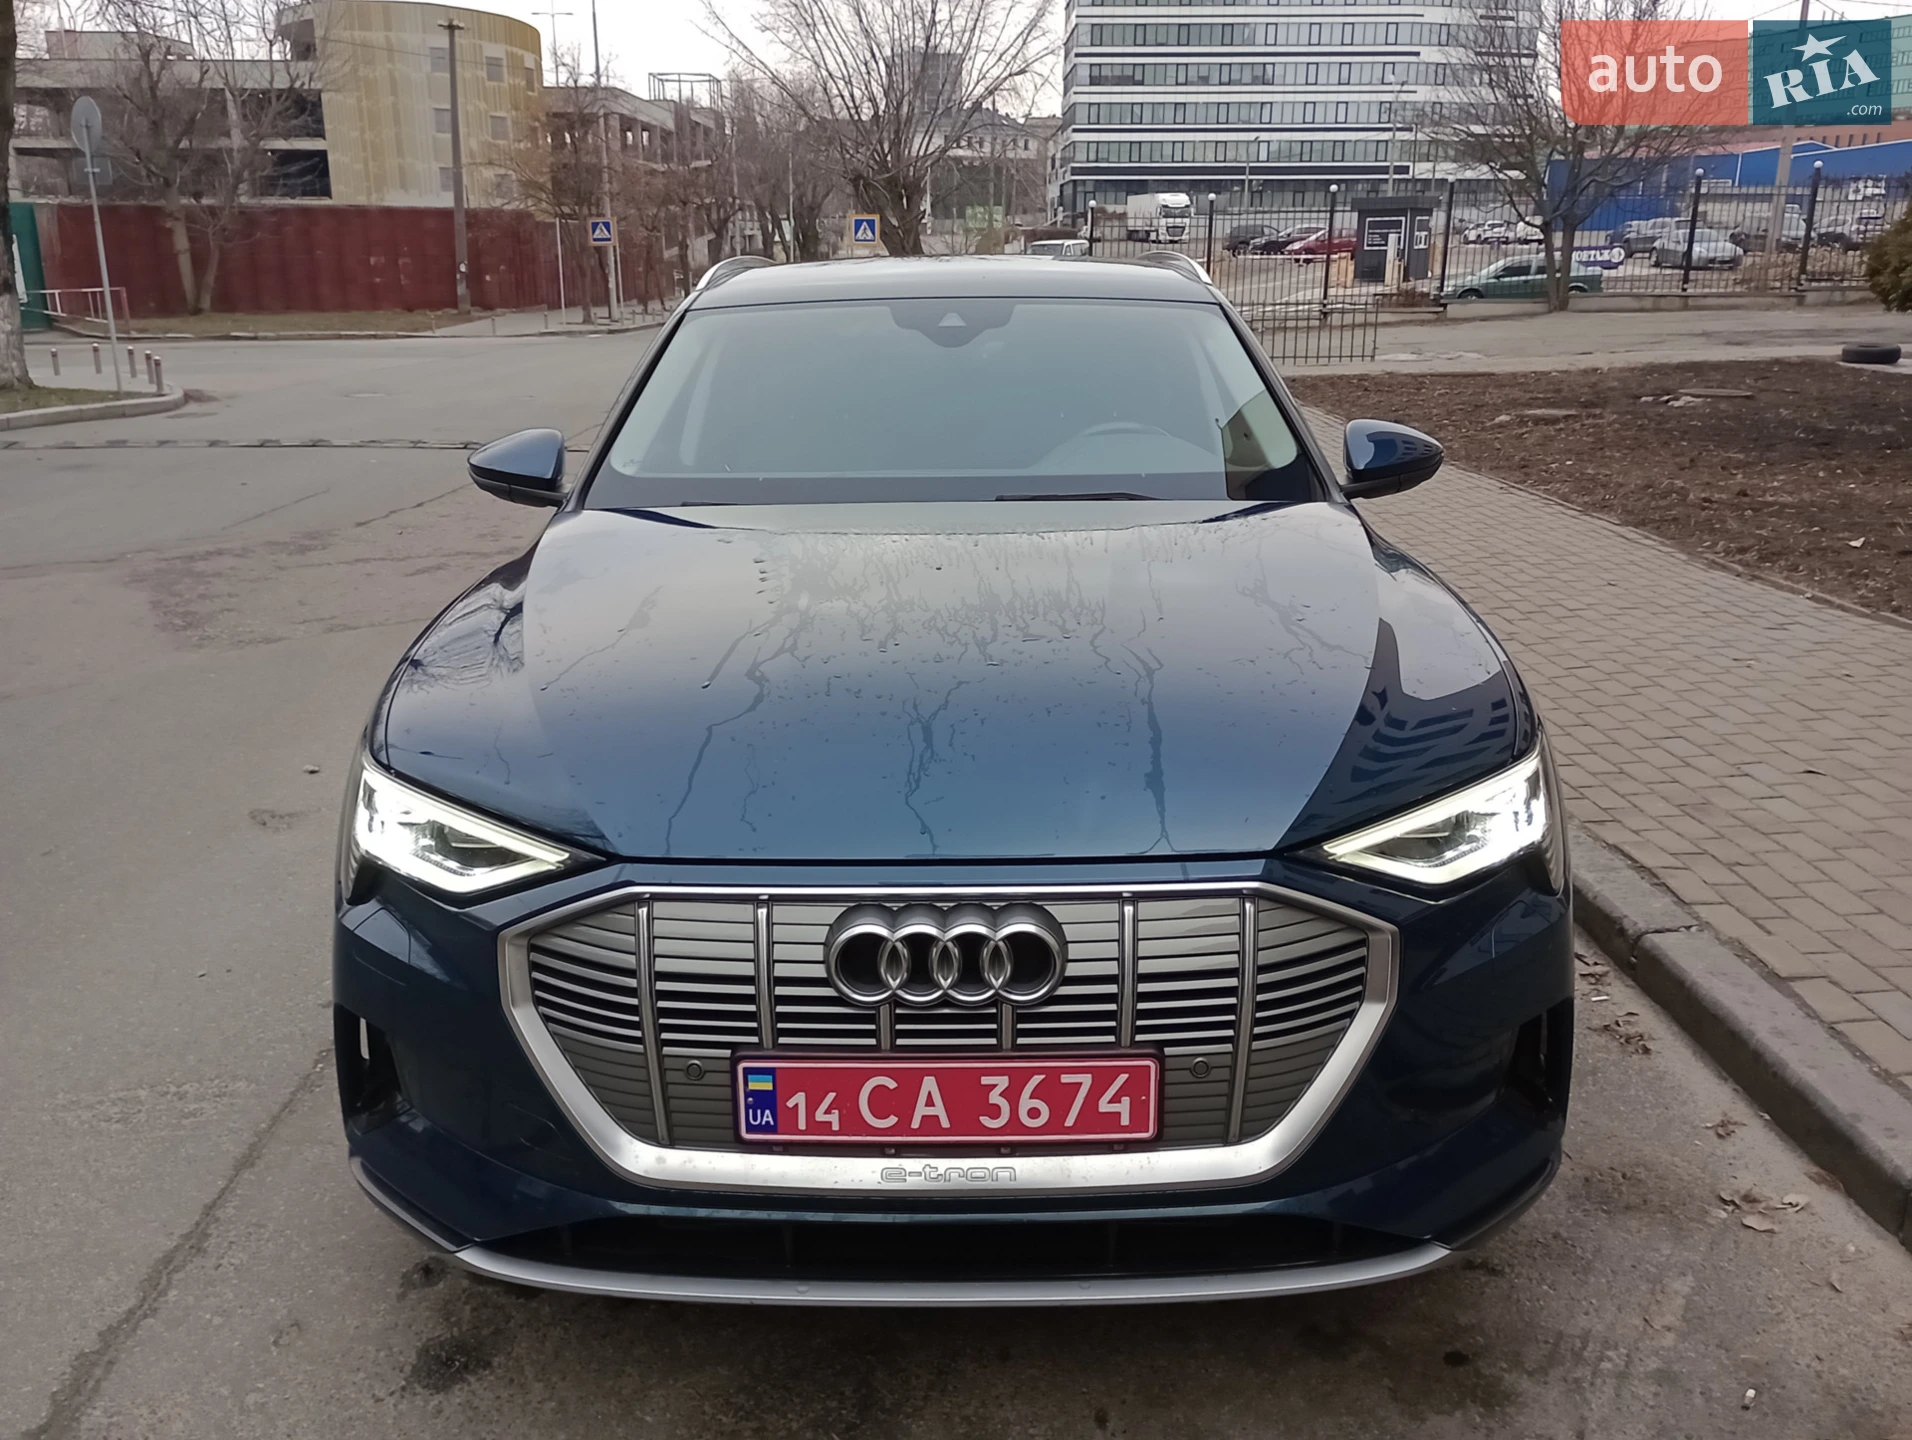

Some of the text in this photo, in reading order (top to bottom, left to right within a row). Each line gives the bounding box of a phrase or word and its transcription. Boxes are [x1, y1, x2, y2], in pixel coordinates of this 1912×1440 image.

[786, 1073, 1131, 1131] 14 CA 3674
[748, 1108, 775, 1126] UA
[880, 1163, 1017, 1183] e-tron
